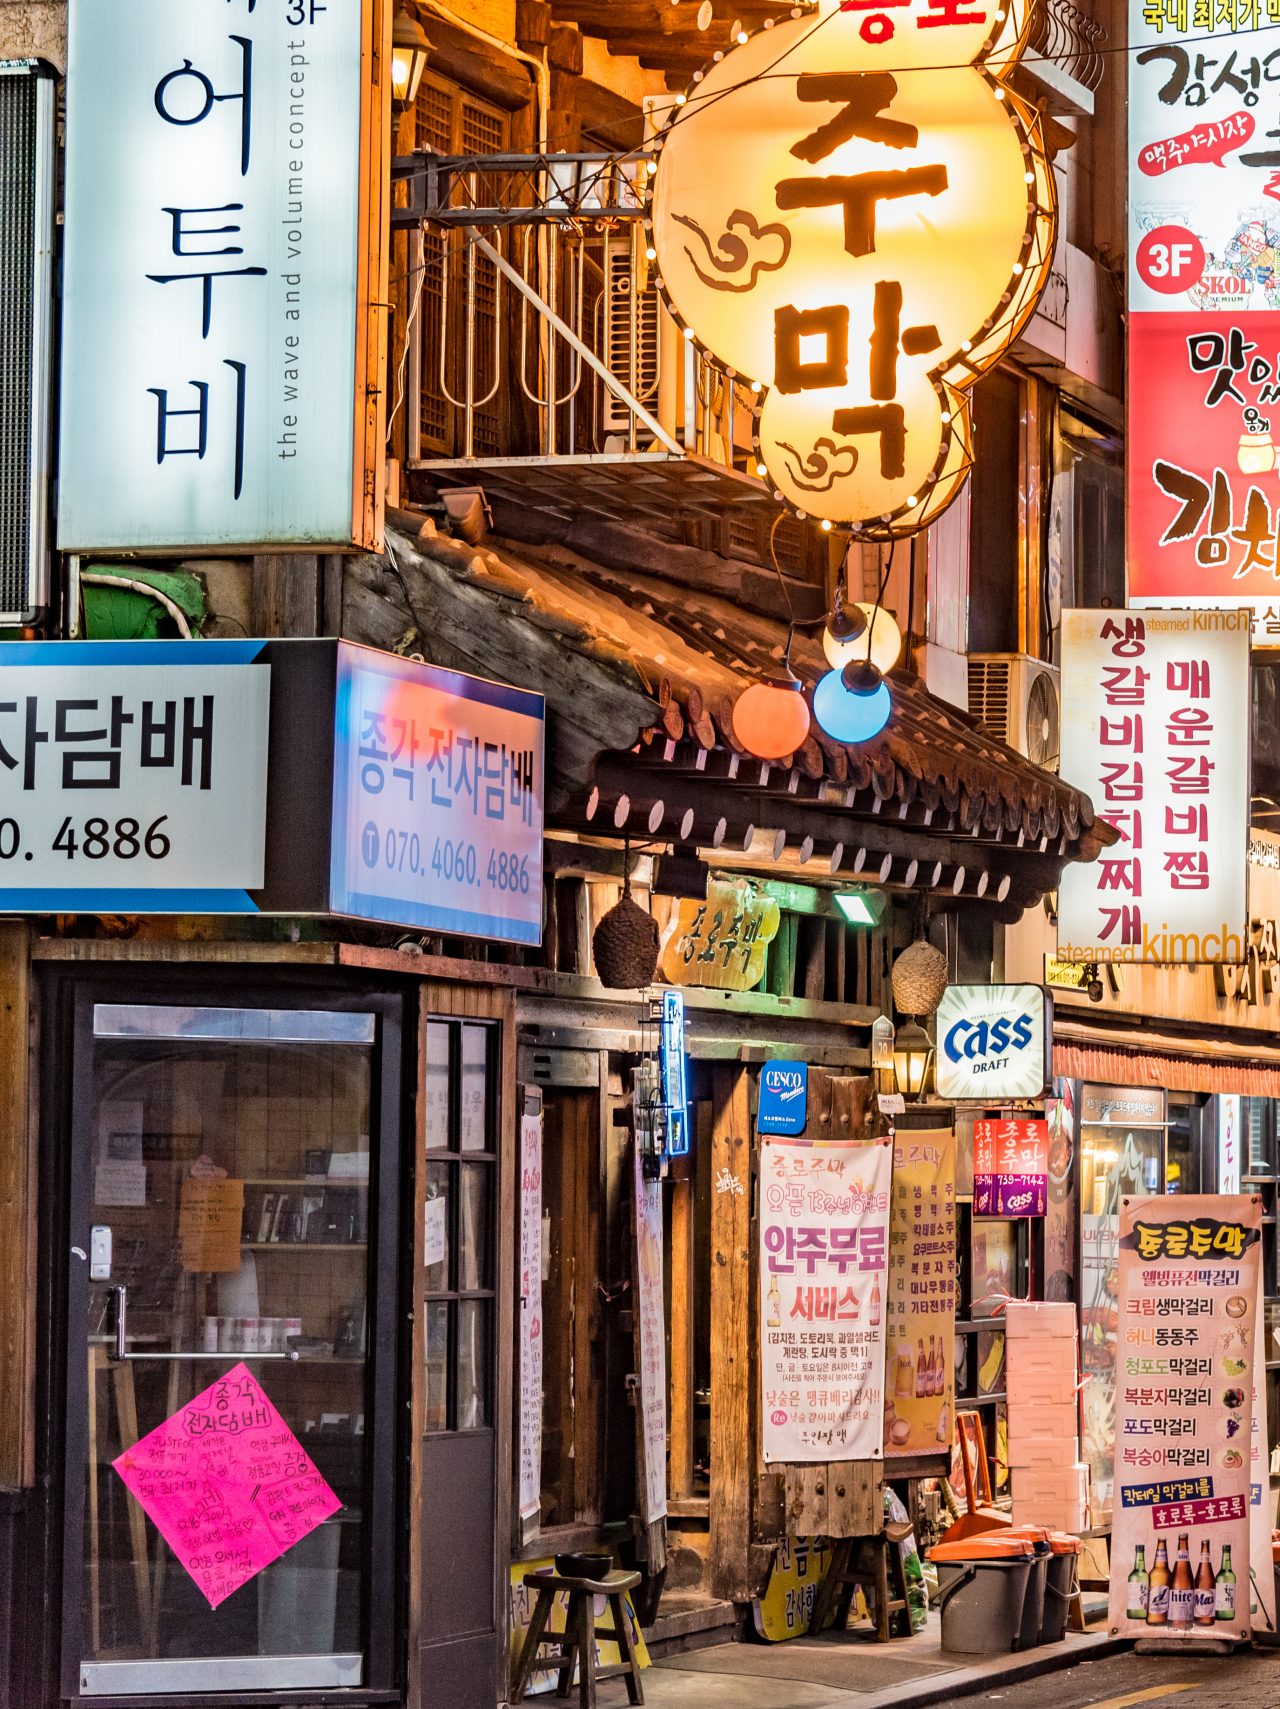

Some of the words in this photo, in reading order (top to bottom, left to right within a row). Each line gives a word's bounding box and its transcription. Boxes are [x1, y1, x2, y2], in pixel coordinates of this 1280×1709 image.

[1193, 0, 1261, 31] 최저가
[287, 39, 311, 150] concept
[282, 160, 304, 259] volume
[146, 0, 268, 500] 어투비
[1148, 243, 1194, 278] 3F
[774, 72, 949, 480] 주막
[1198, 275, 1251, 294] SKOL
[281, 272, 301, 321] and
[284, 334, 301, 402] wave
[278, 413, 298, 460] the
[1146, 617, 1190, 632] steamed
[358, 709, 417, 802] 종각
[427, 729, 534, 828] 전자담배
[1096, 617, 1150, 945] 생갈비김치찌개
[1163, 659, 1216, 891] 매운갈비찜
[52, 815, 171, 861] 4886
[385, 828, 425, 877] 070.
[431, 847, 481, 888] 4060.
[486, 852, 530, 896] 4886
[943, 1012, 1033, 1064] Cass
[766, 1071, 802, 1088] CESCO
[972, 1057, 1009, 1074] DRAFT
[997, 1122, 1041, 1149] 종로
[770, 1154, 846, 1181] 종로주막
[997, 1145, 1044, 1174] 주막
[997, 1174, 1044, 1186] 739-7142
[767, 1182, 805, 1217] 오픈
[764, 1225, 887, 1275] 안주무료
[1142, 1269, 1240, 1287] 웰빙퓨전막걸리
[788, 1285, 861, 1323] 서비스
[1126, 1297, 1214, 1316] 크림생막걸리
[1126, 1327, 1199, 1346] 허니동동주
[1125, 1357, 1213, 1377] 청포도막걸리
[216, 1381, 255, 1410] 종각
[1124, 1387, 1212, 1406] 복분자막걸리
[187, 1407, 268, 1435] 전자담배
[1123, 1417, 1197, 1437] 포도막걸리
[1122, 1448, 1210, 1467] 복숭아막걸리
[1124, 1487, 1160, 1504] 칵테일
[1162, 1478, 1212, 1499] 막걸리를
[1171, 1589, 1193, 1603] hite
